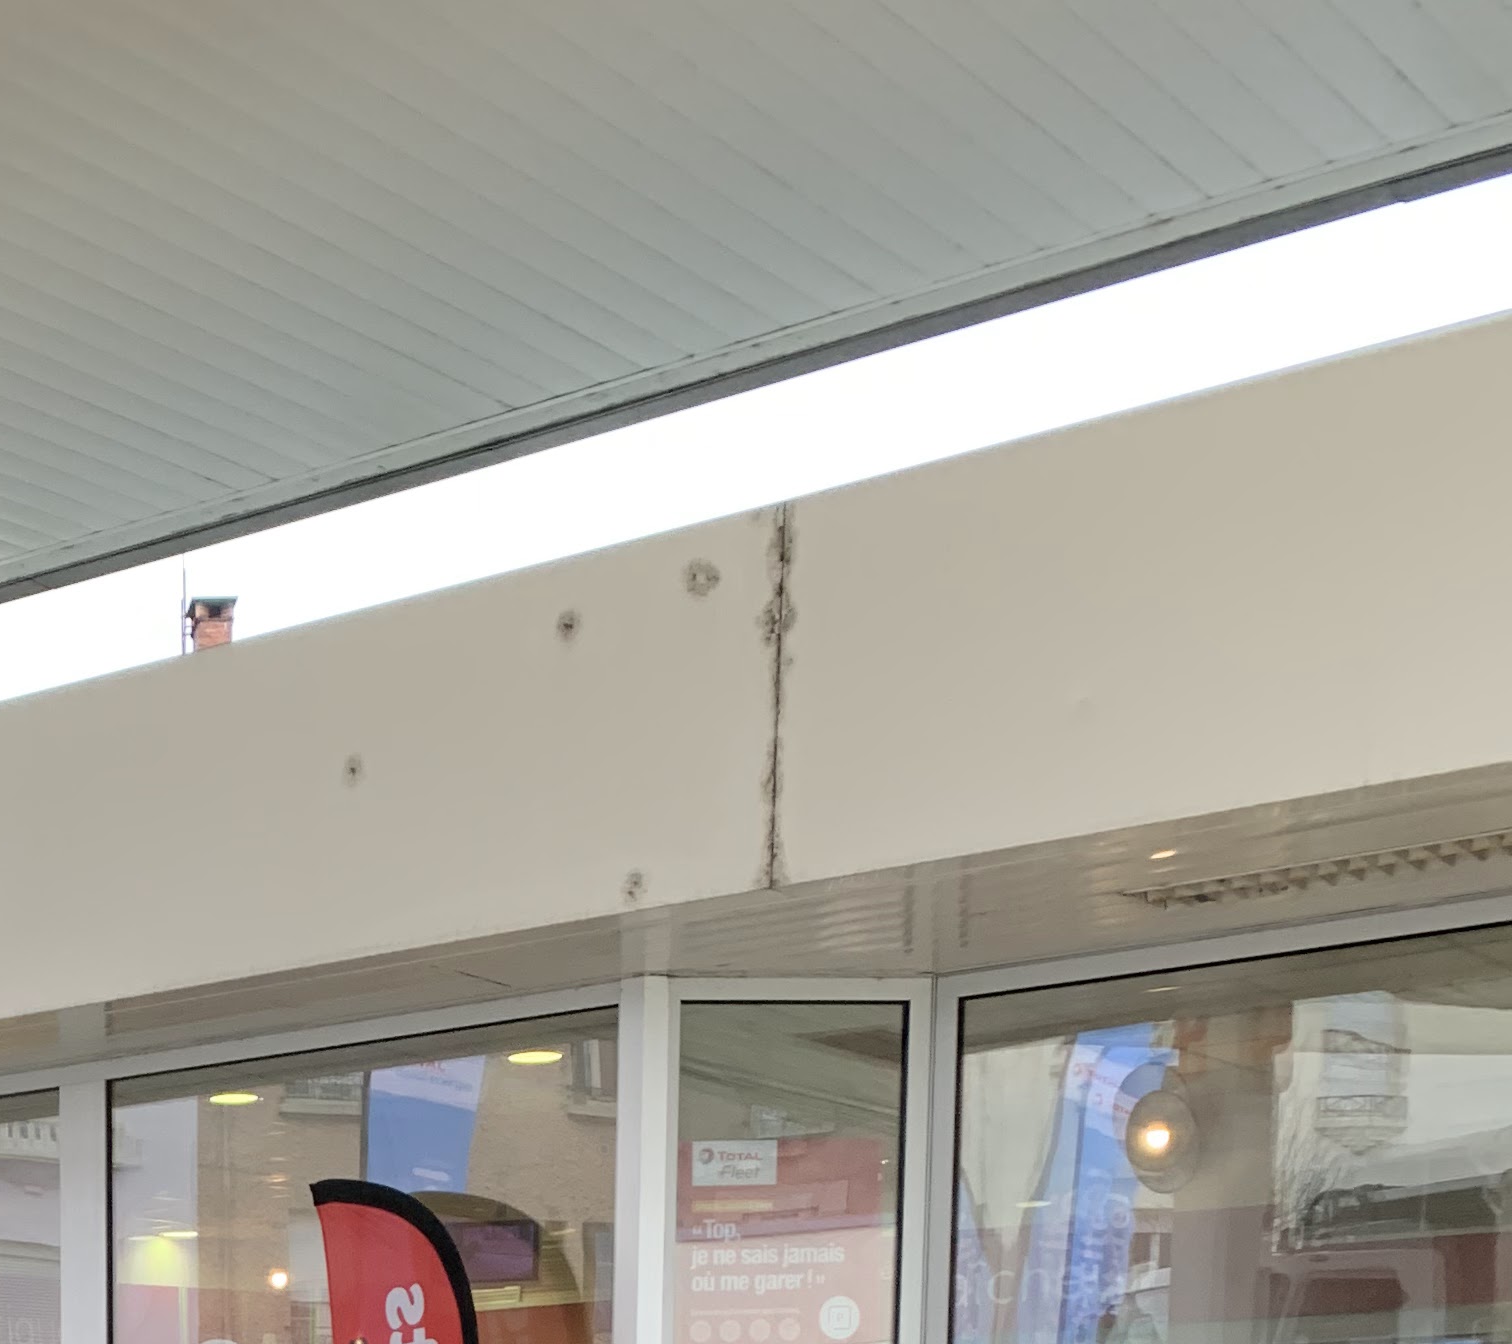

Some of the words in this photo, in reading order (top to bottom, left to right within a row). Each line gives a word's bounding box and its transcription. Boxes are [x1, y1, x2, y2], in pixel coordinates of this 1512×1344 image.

[717, 1150, 763, 1162] TOTAL
[690, 1246, 708, 1270] je
[713, 1250, 736, 1265] ne
[741, 1245, 778, 1265] sais
[782, 1242, 845, 1267] jamais
[720, 1274, 749, 1291] me
